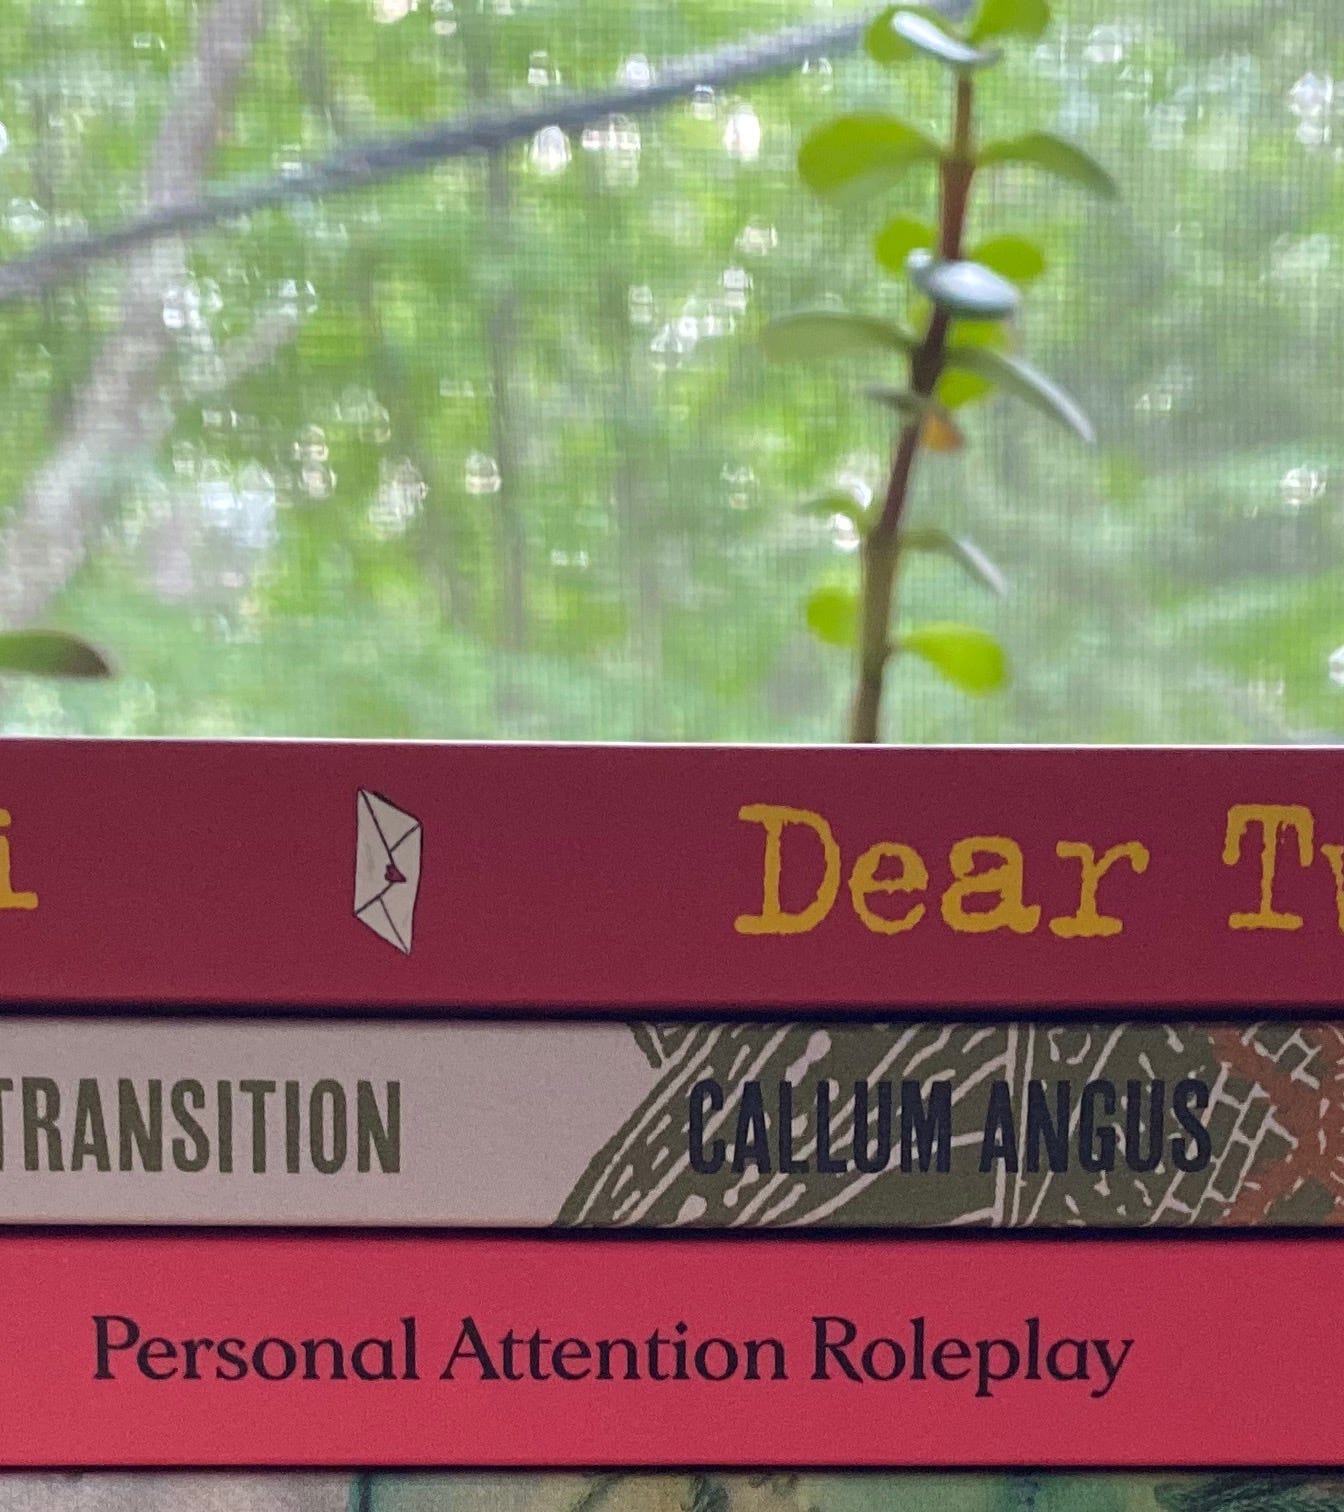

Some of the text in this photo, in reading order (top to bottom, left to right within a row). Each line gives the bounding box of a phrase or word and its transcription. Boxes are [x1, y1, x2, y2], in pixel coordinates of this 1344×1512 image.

[733, 803, 1149, 938] Dear
[687, 1078, 1214, 1177] CALLUM ANGUS
[91, 1314, 1134, 1398] Personal Attention Roleplay
